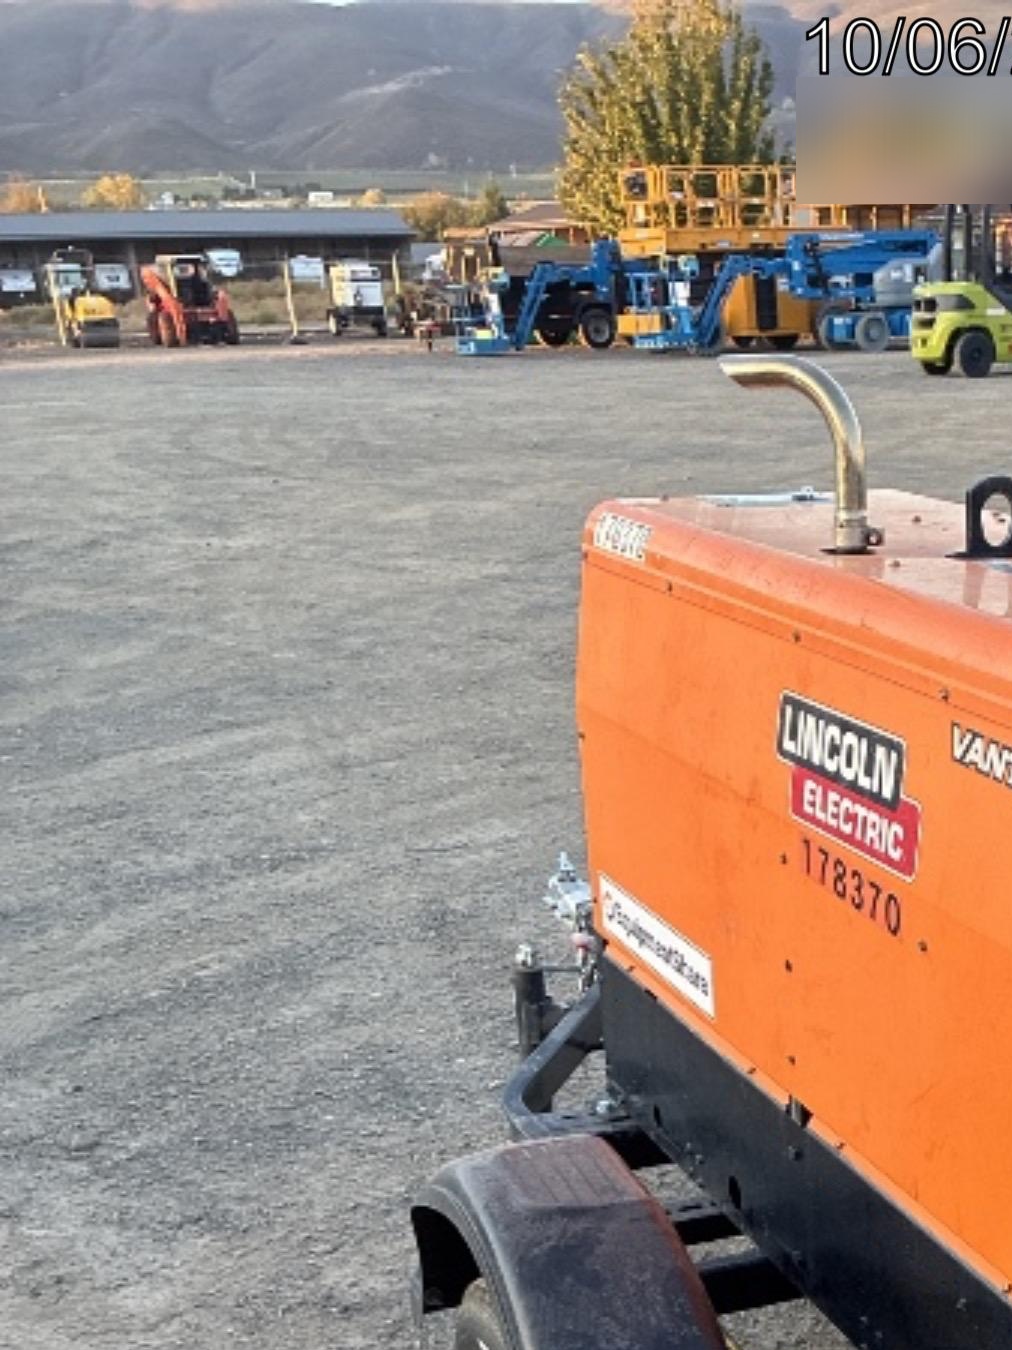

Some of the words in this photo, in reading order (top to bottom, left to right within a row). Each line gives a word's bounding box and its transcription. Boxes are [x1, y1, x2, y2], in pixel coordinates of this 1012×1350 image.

[782, 703, 899, 801] LINCOLN
[802, 779, 905, 862] ELECTRIC
[803, 836, 901, 937] 178370
